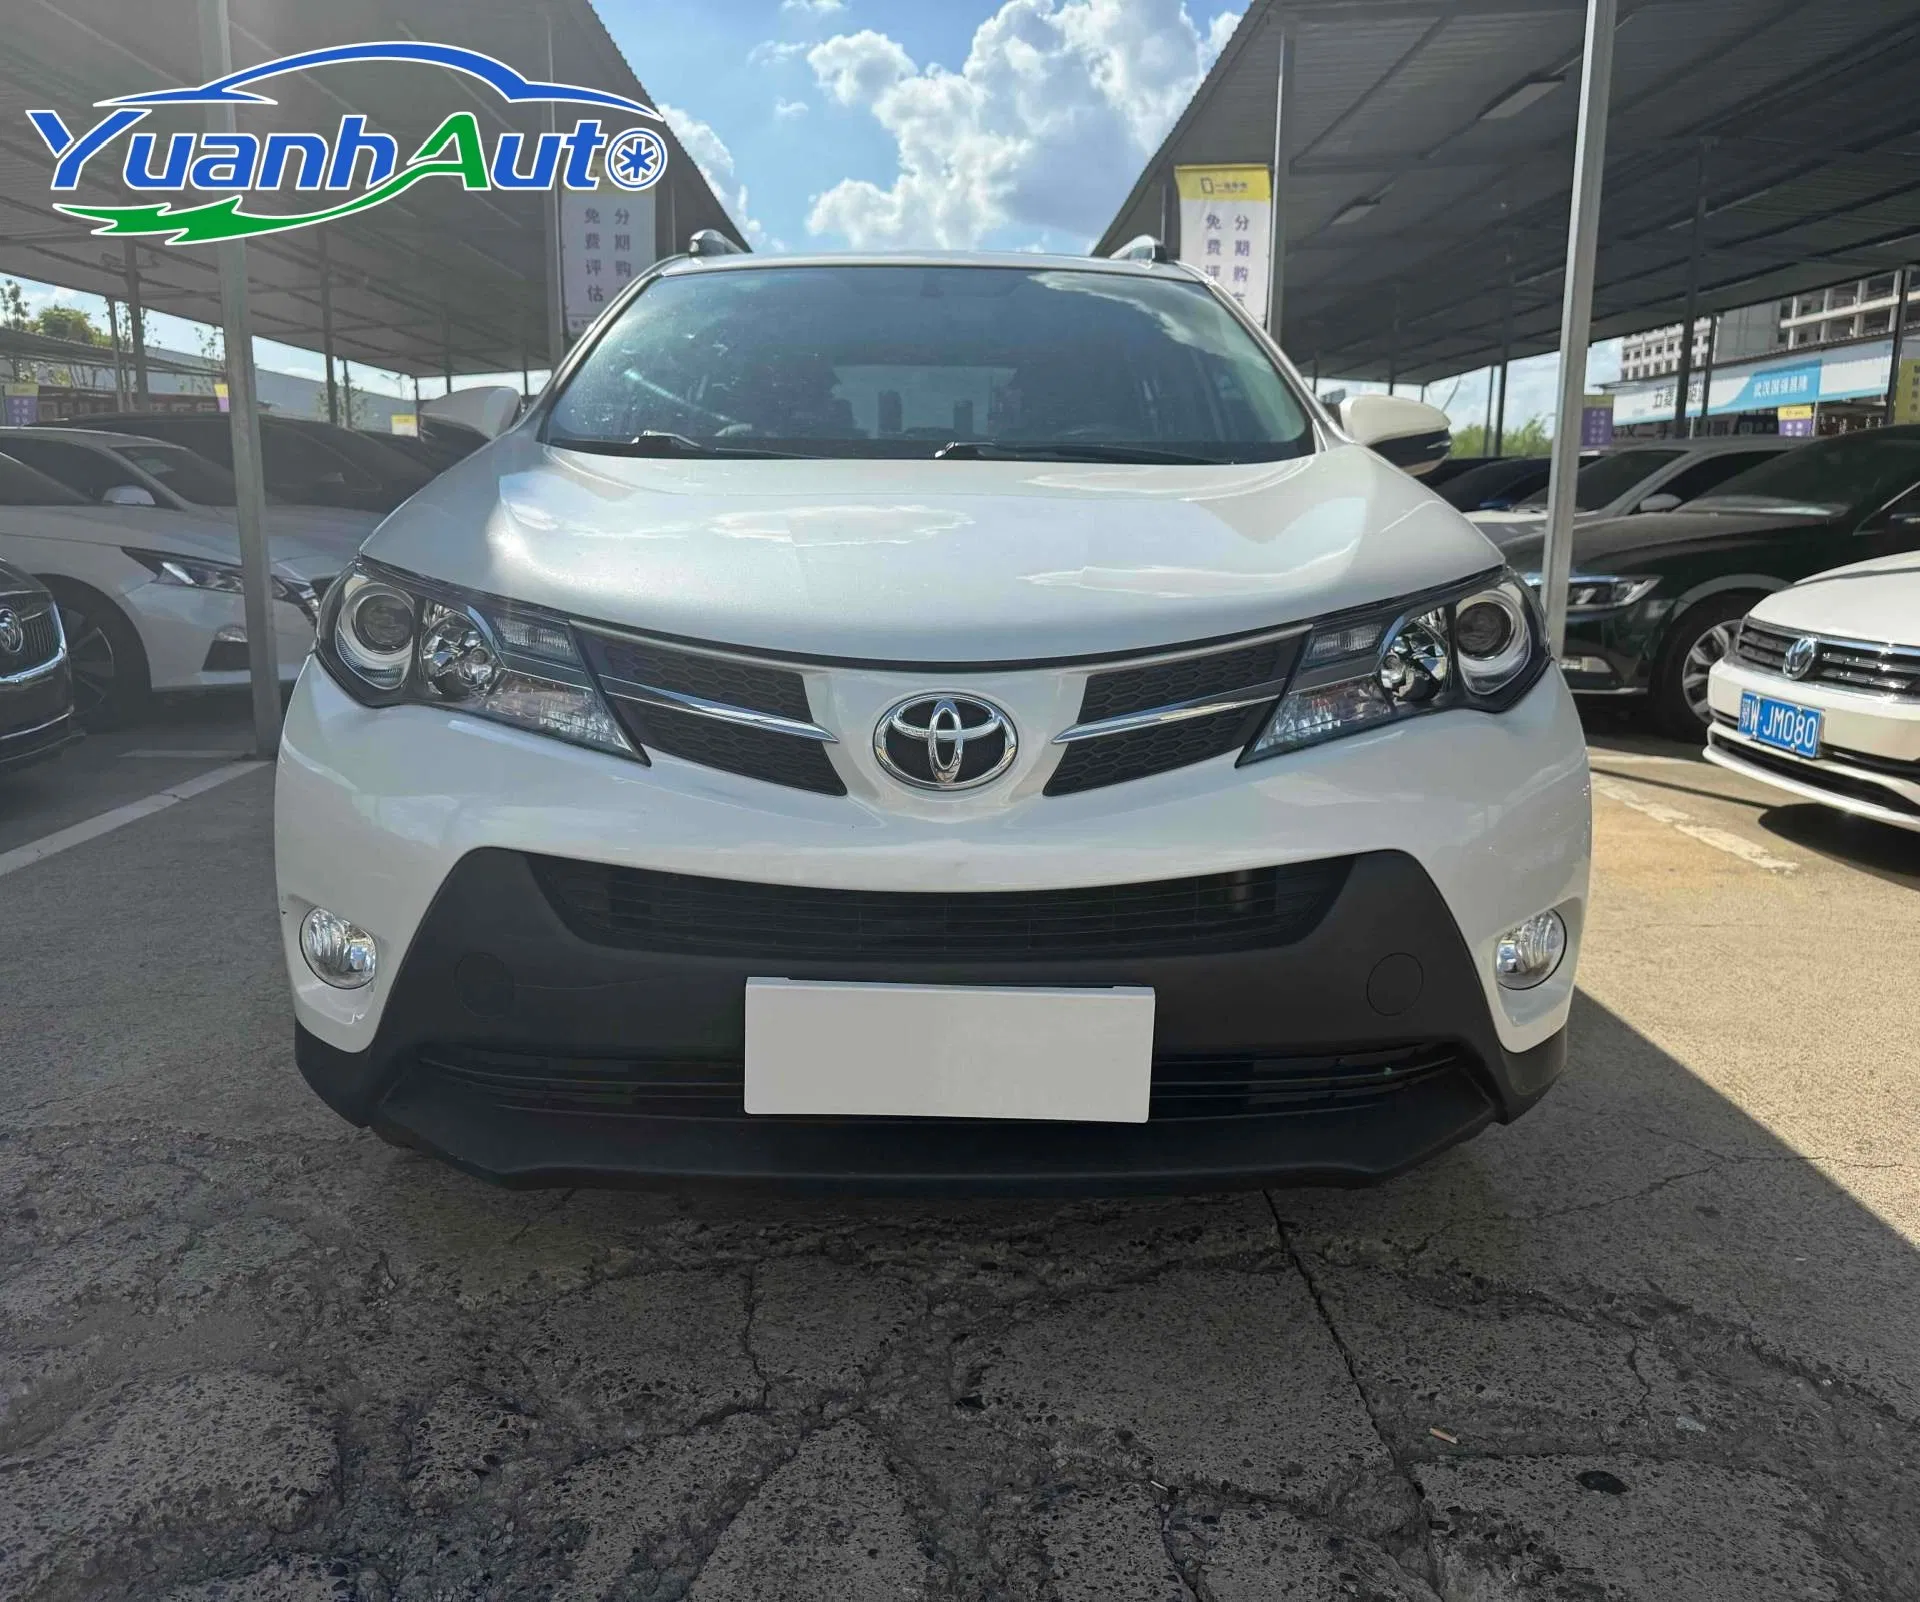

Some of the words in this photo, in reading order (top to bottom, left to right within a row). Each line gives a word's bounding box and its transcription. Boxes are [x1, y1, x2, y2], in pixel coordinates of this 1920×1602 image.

[585, 208, 603, 302] 免费评估
[614, 208, 632, 291] 分期购
